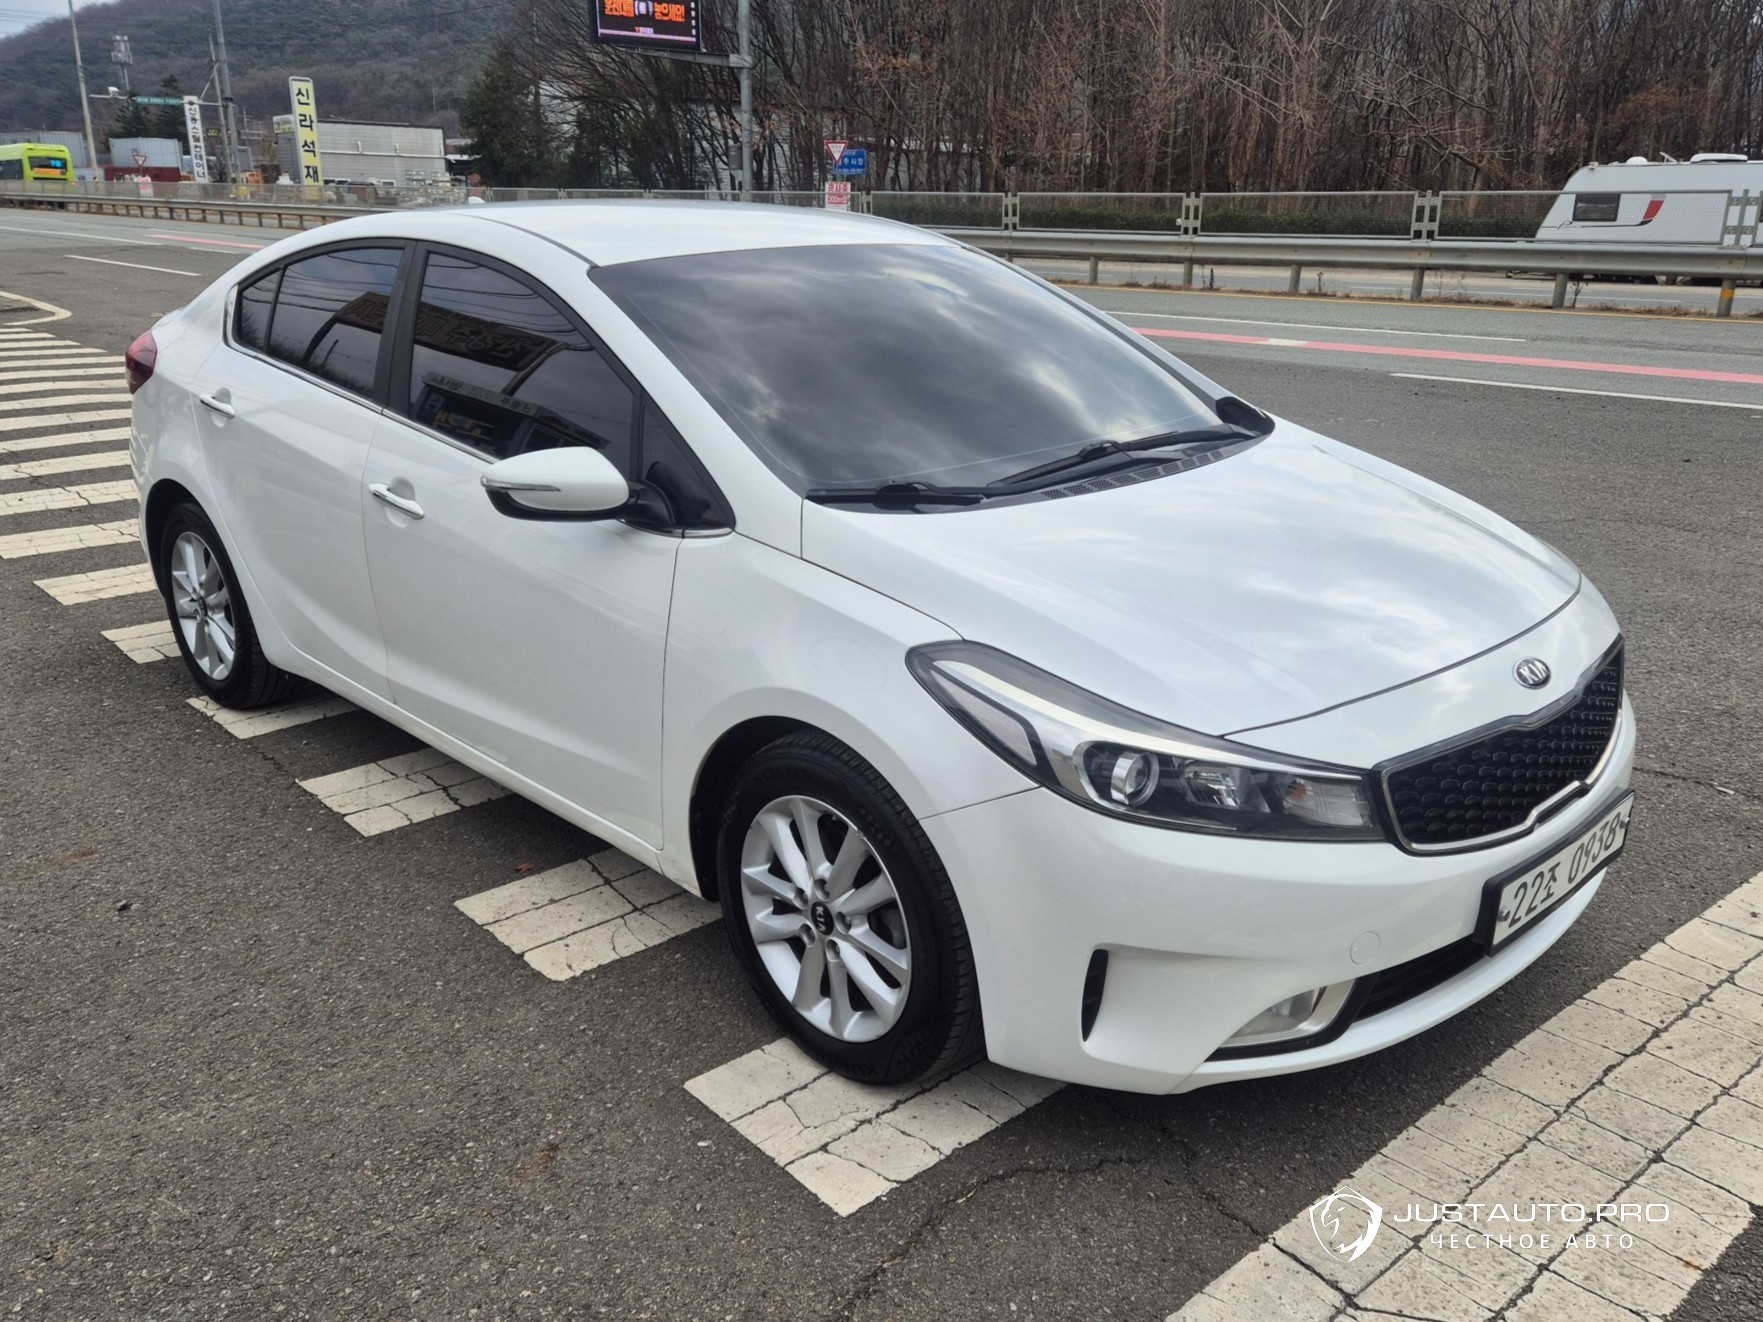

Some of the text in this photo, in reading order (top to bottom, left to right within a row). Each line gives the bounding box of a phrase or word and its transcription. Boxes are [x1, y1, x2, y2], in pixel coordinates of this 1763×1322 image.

[295, 87, 320, 183] 신라석재
[1519, 661, 1550, 684] KIA
[1508, 811, 1621, 928] 22조 0938
[816, 906, 826, 931] KIA
